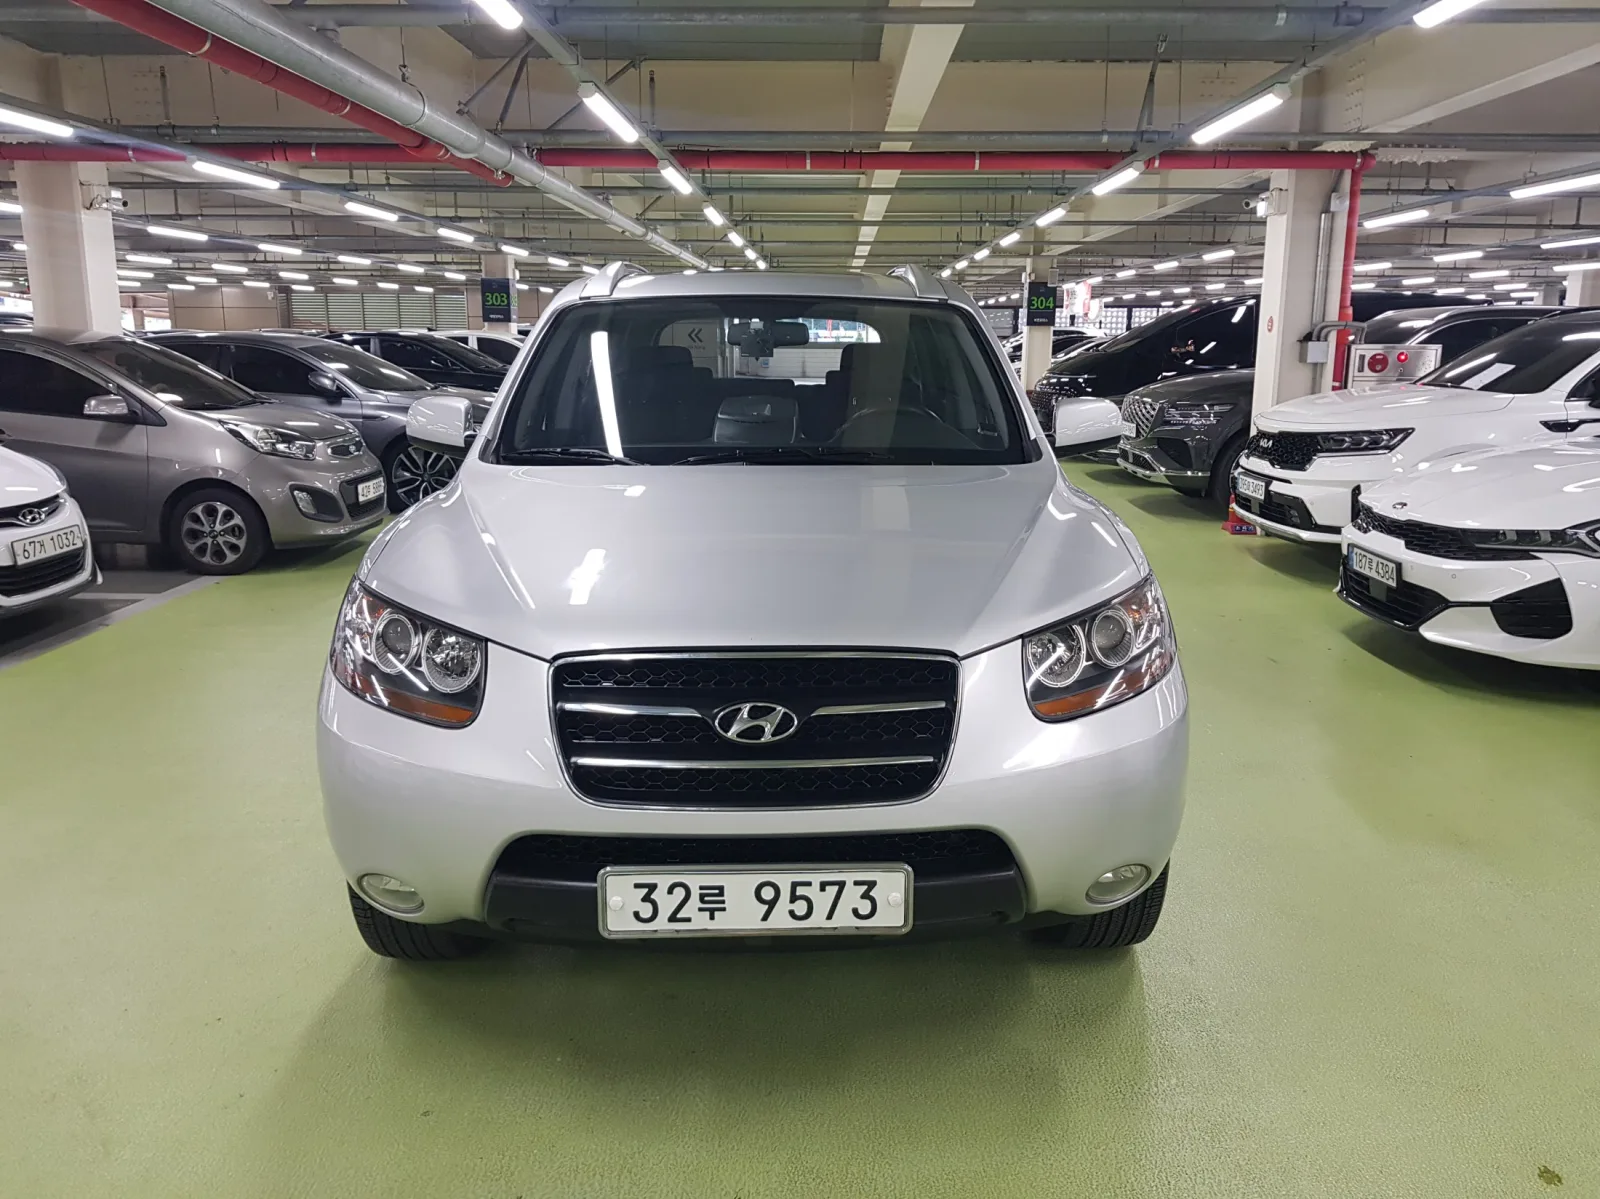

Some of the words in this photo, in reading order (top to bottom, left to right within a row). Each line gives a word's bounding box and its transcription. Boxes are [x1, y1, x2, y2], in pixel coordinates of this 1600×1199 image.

[485, 292, 508, 306] 303
[1030, 296, 1055, 309] 304
[22, 540, 47, 560] 67거
[50, 530, 77, 552] 1032
[1355, 551, 1373, 573] 187루
[1375, 560, 1395, 583] 4384
[632, 881, 727, 923] 32루
[754, 880, 878, 922] 9573
